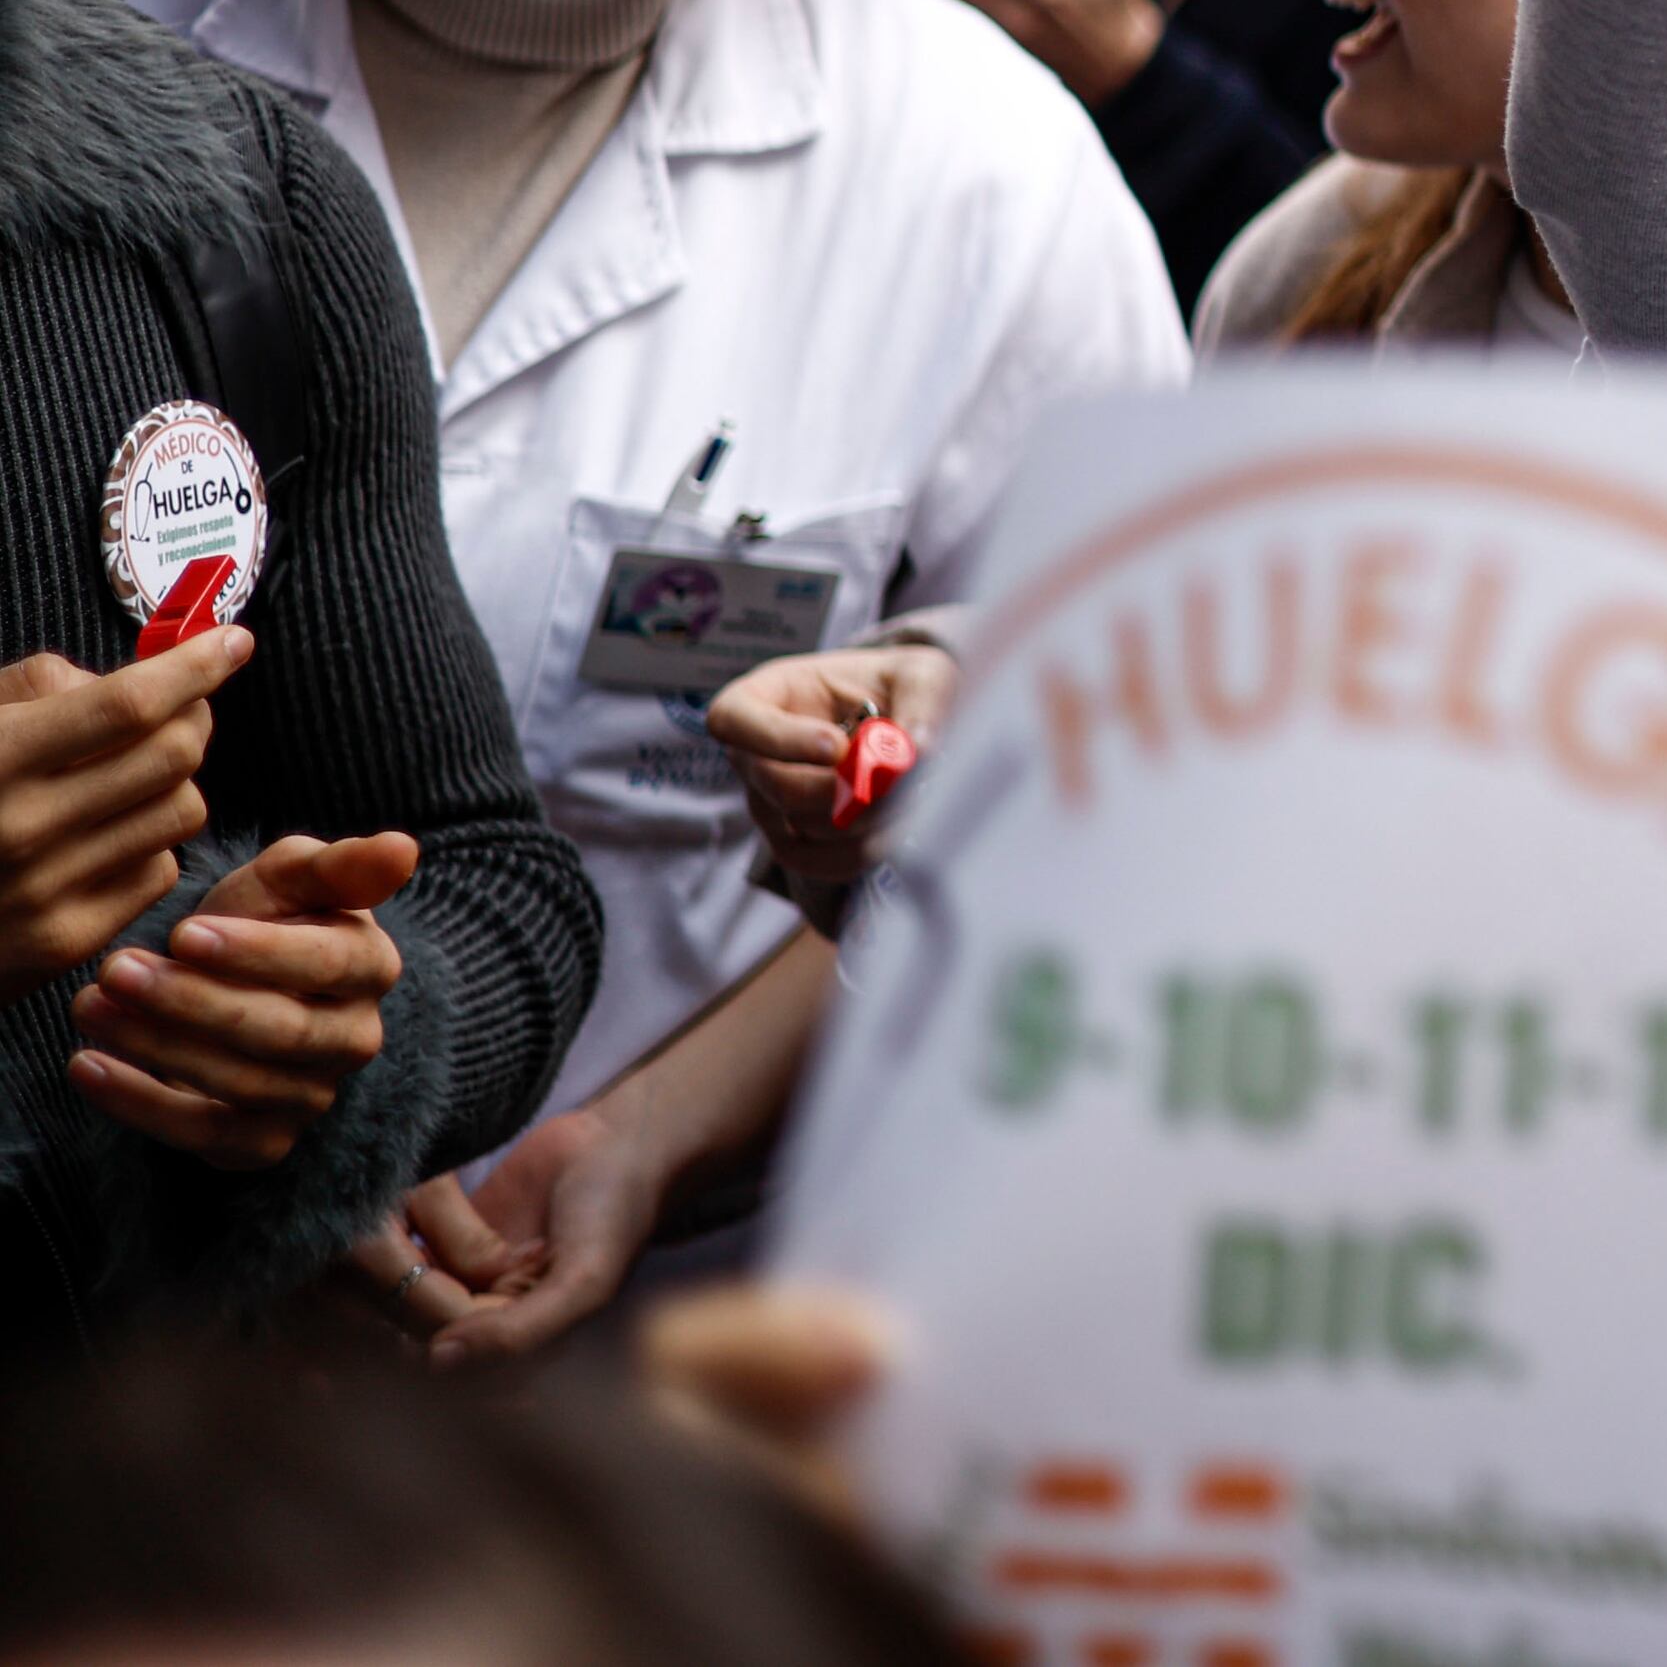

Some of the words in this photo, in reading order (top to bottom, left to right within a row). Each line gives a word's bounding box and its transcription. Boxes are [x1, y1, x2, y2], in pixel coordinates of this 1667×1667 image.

[154, 432, 221, 470] MÉDICO
[181, 459, 194, 474] DE
[153, 477, 233, 519] HUELGA
[1190, 1209, 1525, 1381] DIC.
